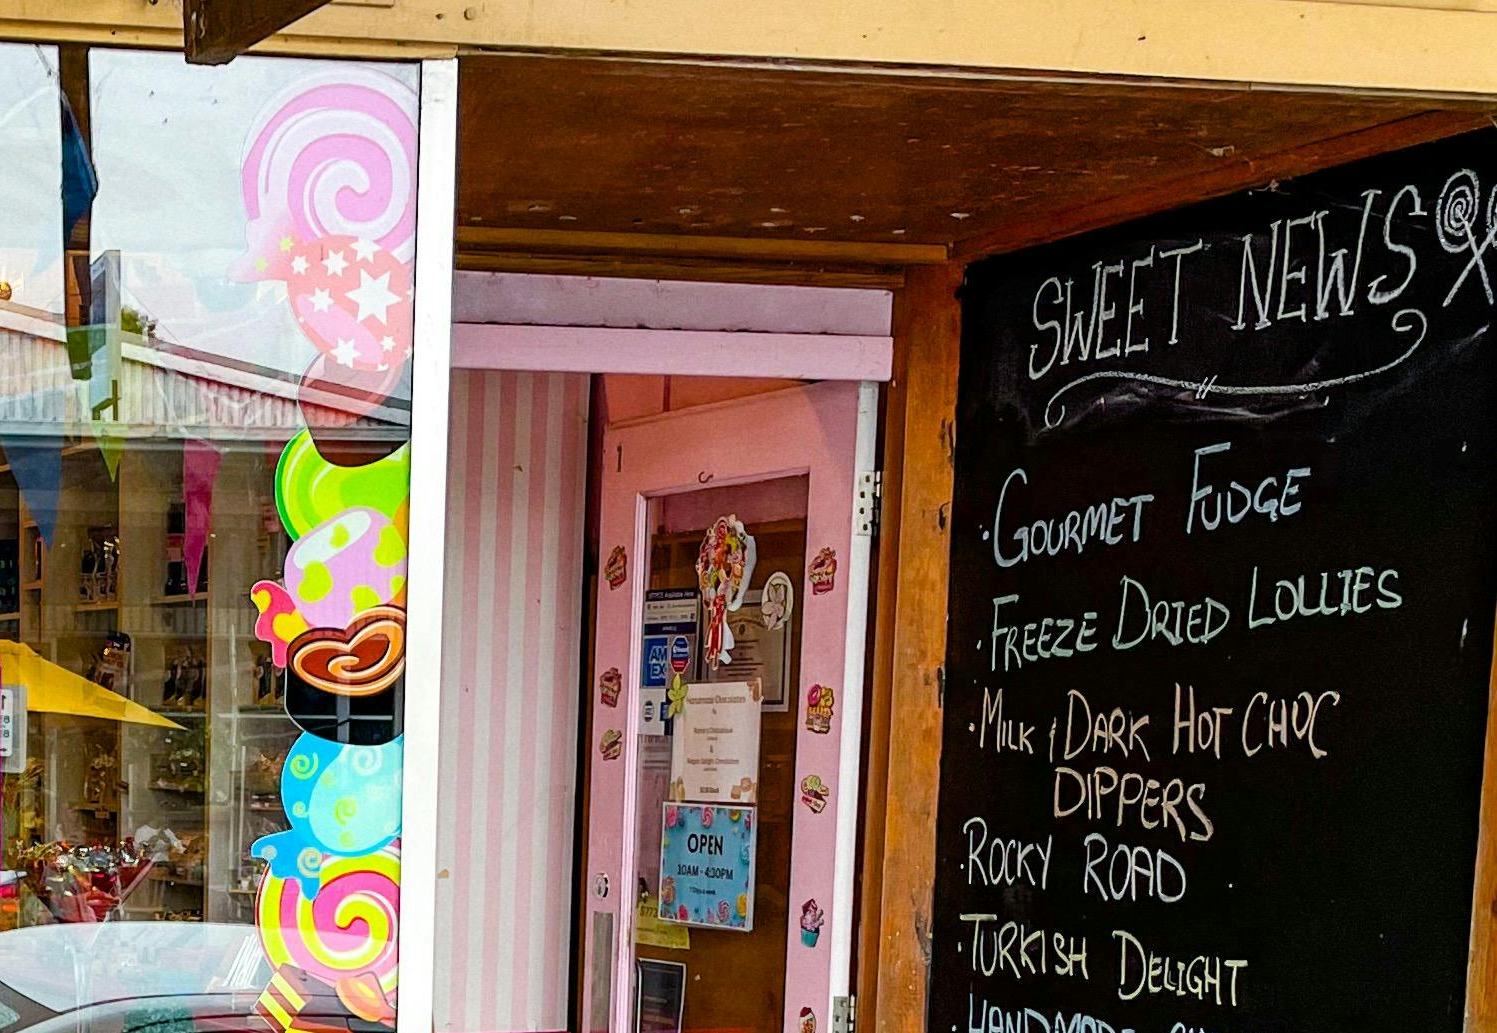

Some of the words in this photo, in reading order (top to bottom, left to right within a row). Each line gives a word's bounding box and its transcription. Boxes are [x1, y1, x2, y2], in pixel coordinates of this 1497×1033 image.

[1029, 238, 1204, 380] SWEET
[1231, 184, 1428, 331] NEWS
[992, 467, 1154, 567] GOURMET
[1186, 441, 1311, 535] FUDGE
[990, 594, 1098, 671] FREEZE
[1112, 575, 1231, 652] DRIED
[1247, 566, 1403, 630] LOLLIES
[979, 686, 1036, 756] MILK
[1064, 687, 1152, 761] DARK
[1173, 682, 1234, 760] HOT
[1242, 690, 1341, 759] CHOC
[687, 833, 724, 856] OPEN
[1053, 766, 1215, 842] DIPPERS
[677, 863, 699, 877] 10AM
[963, 817, 1054, 888] ROCKY
[1083, 832, 1187, 903] ROAD
[960, 913, 1089, 979] TURKISH
[1112, 930, 1249, 1006] DELIGHT
